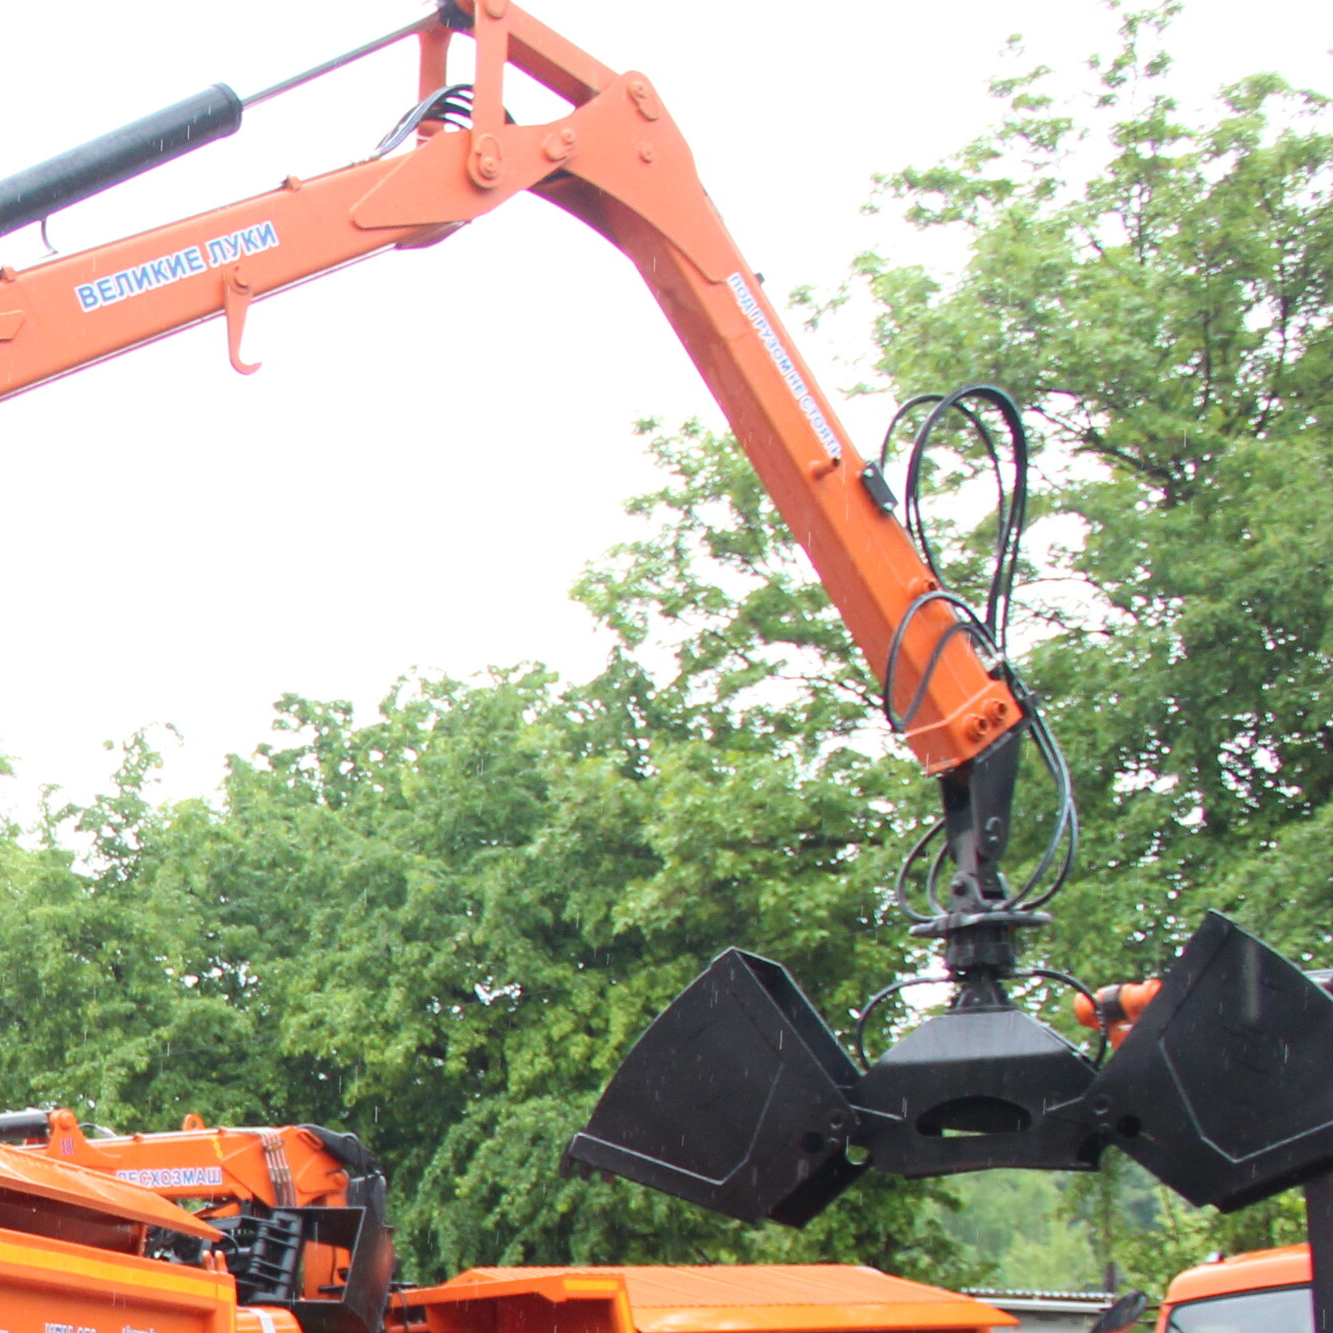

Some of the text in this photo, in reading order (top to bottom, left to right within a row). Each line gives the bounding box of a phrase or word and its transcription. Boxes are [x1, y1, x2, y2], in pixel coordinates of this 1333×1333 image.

[75, 221, 279, 312] ВЕЛИКИЕ ЛУКИ
[726, 271, 757, 314] ПОД
[747, 308, 794, 376] ГРУЗОМ
[785, 371, 808, 399] НЕ
